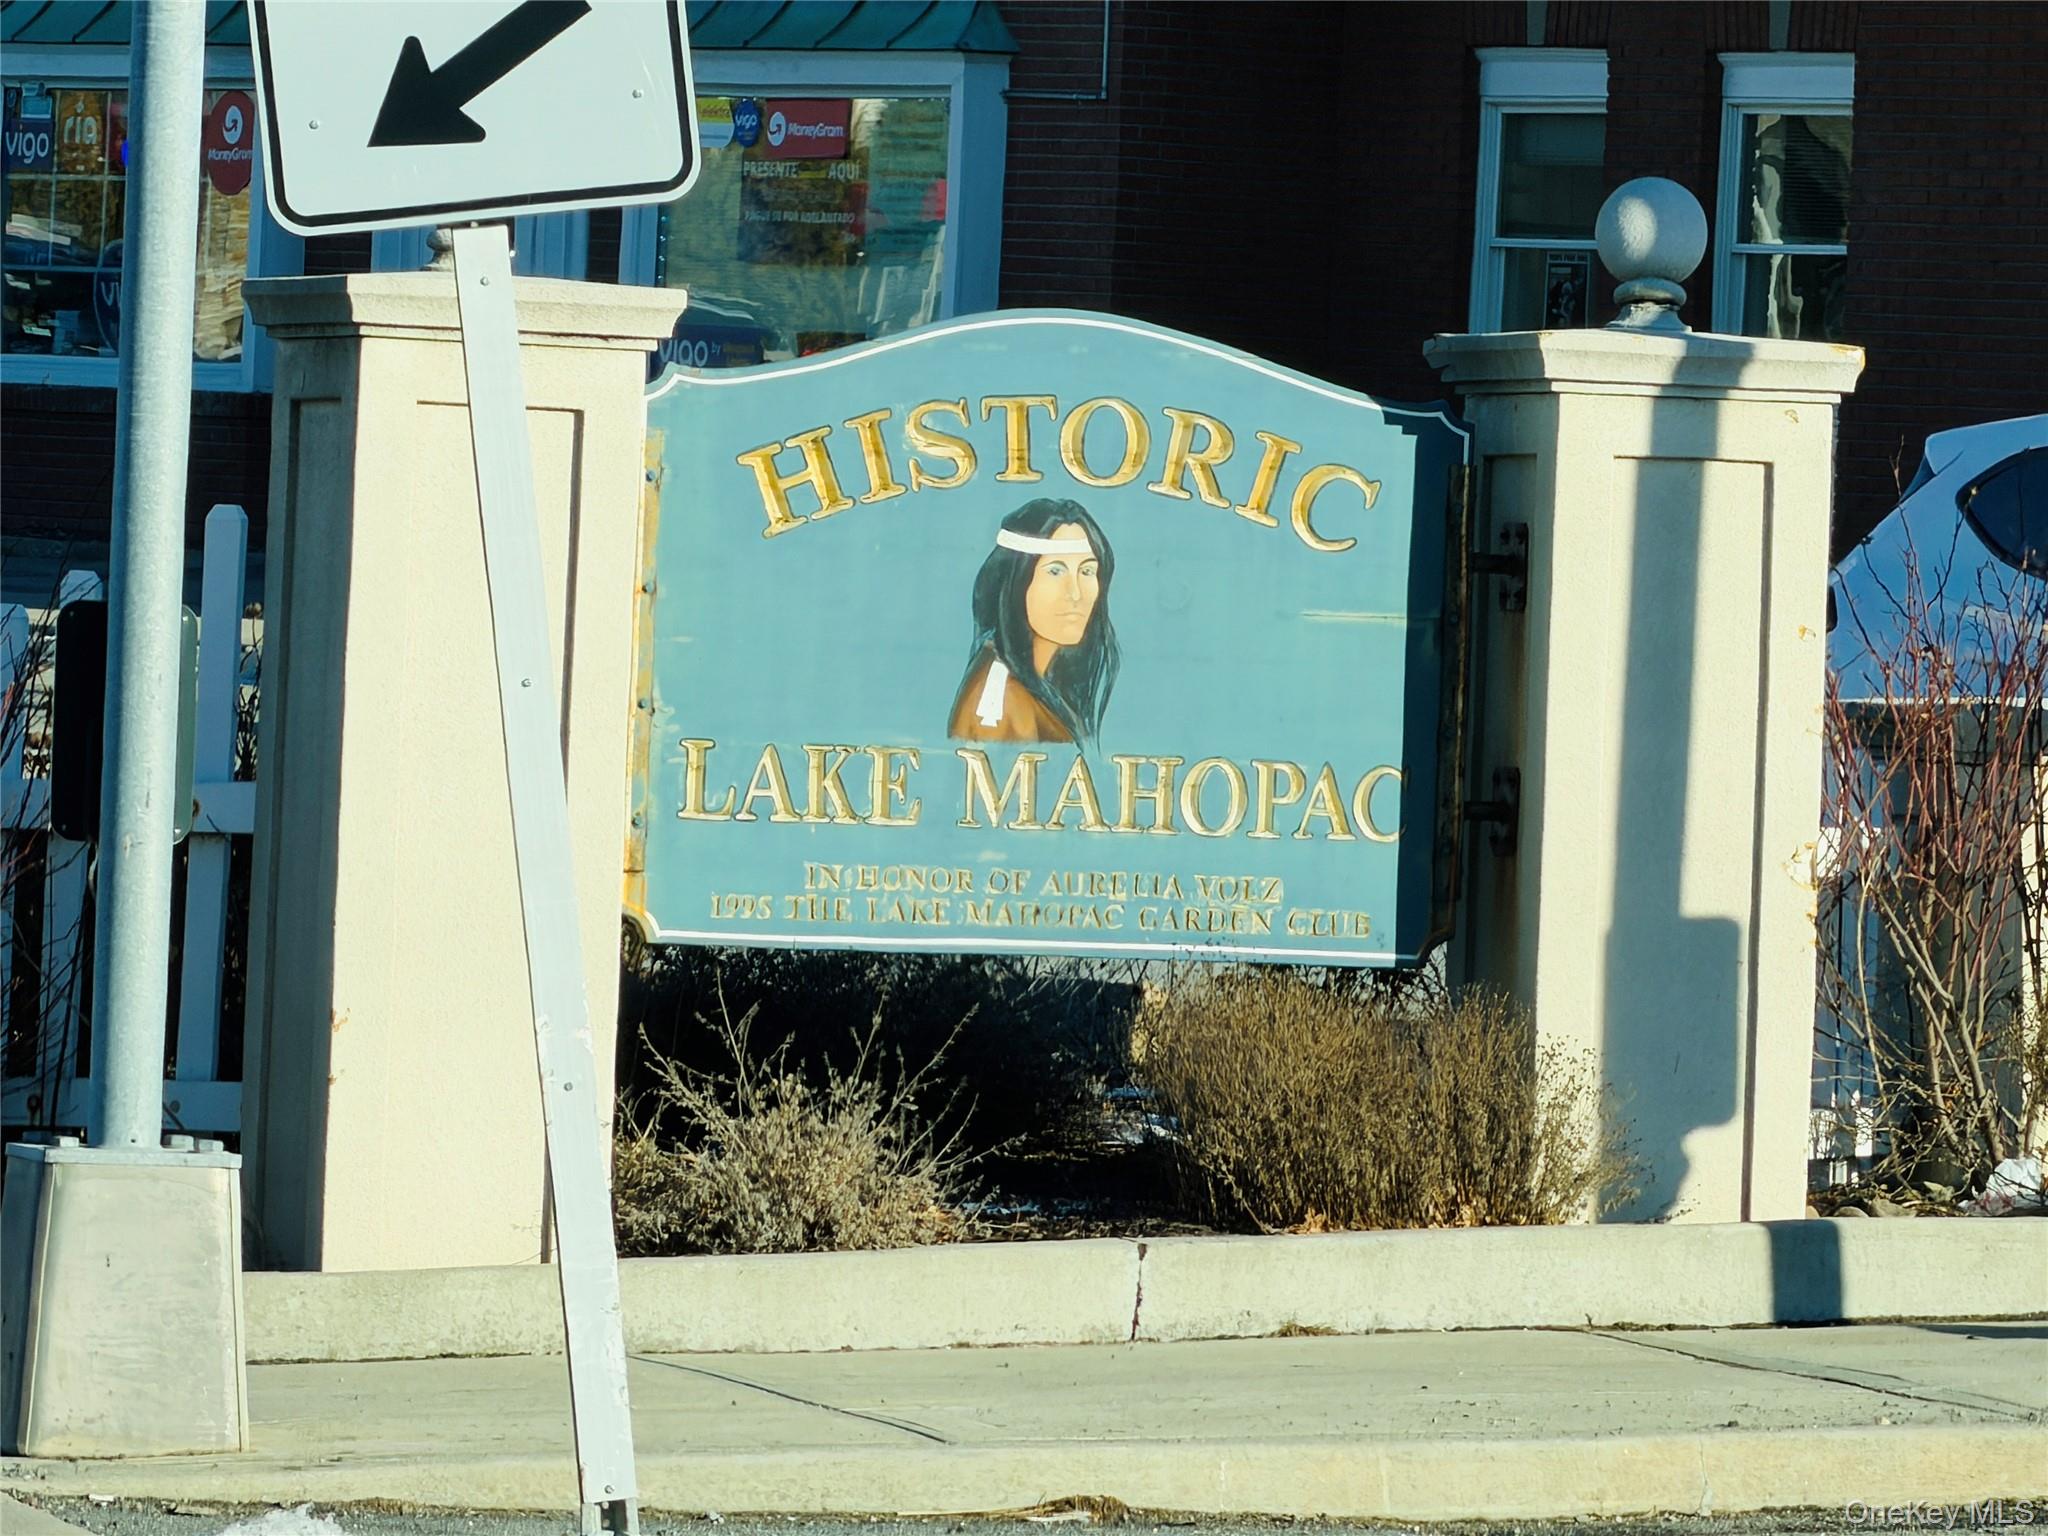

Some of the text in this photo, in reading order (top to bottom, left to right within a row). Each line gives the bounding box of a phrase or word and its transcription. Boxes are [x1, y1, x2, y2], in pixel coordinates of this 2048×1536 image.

[5, 124, 49, 164] vigo
[64, 101, 97, 144] ria
[788, 122, 844, 140] MoneyGram
[743, 160, 800, 178] PRESENTE
[736, 394, 1383, 552] HISTORIC
[677, 738, 1406, 843] LAKE MAHOPAC
[803, 861, 1284, 905] IN HONOR OF AURELIA VOLZ
[711, 893, 1373, 938] 1995 THE LAKE MAHOPAC GARDEN CLUB
